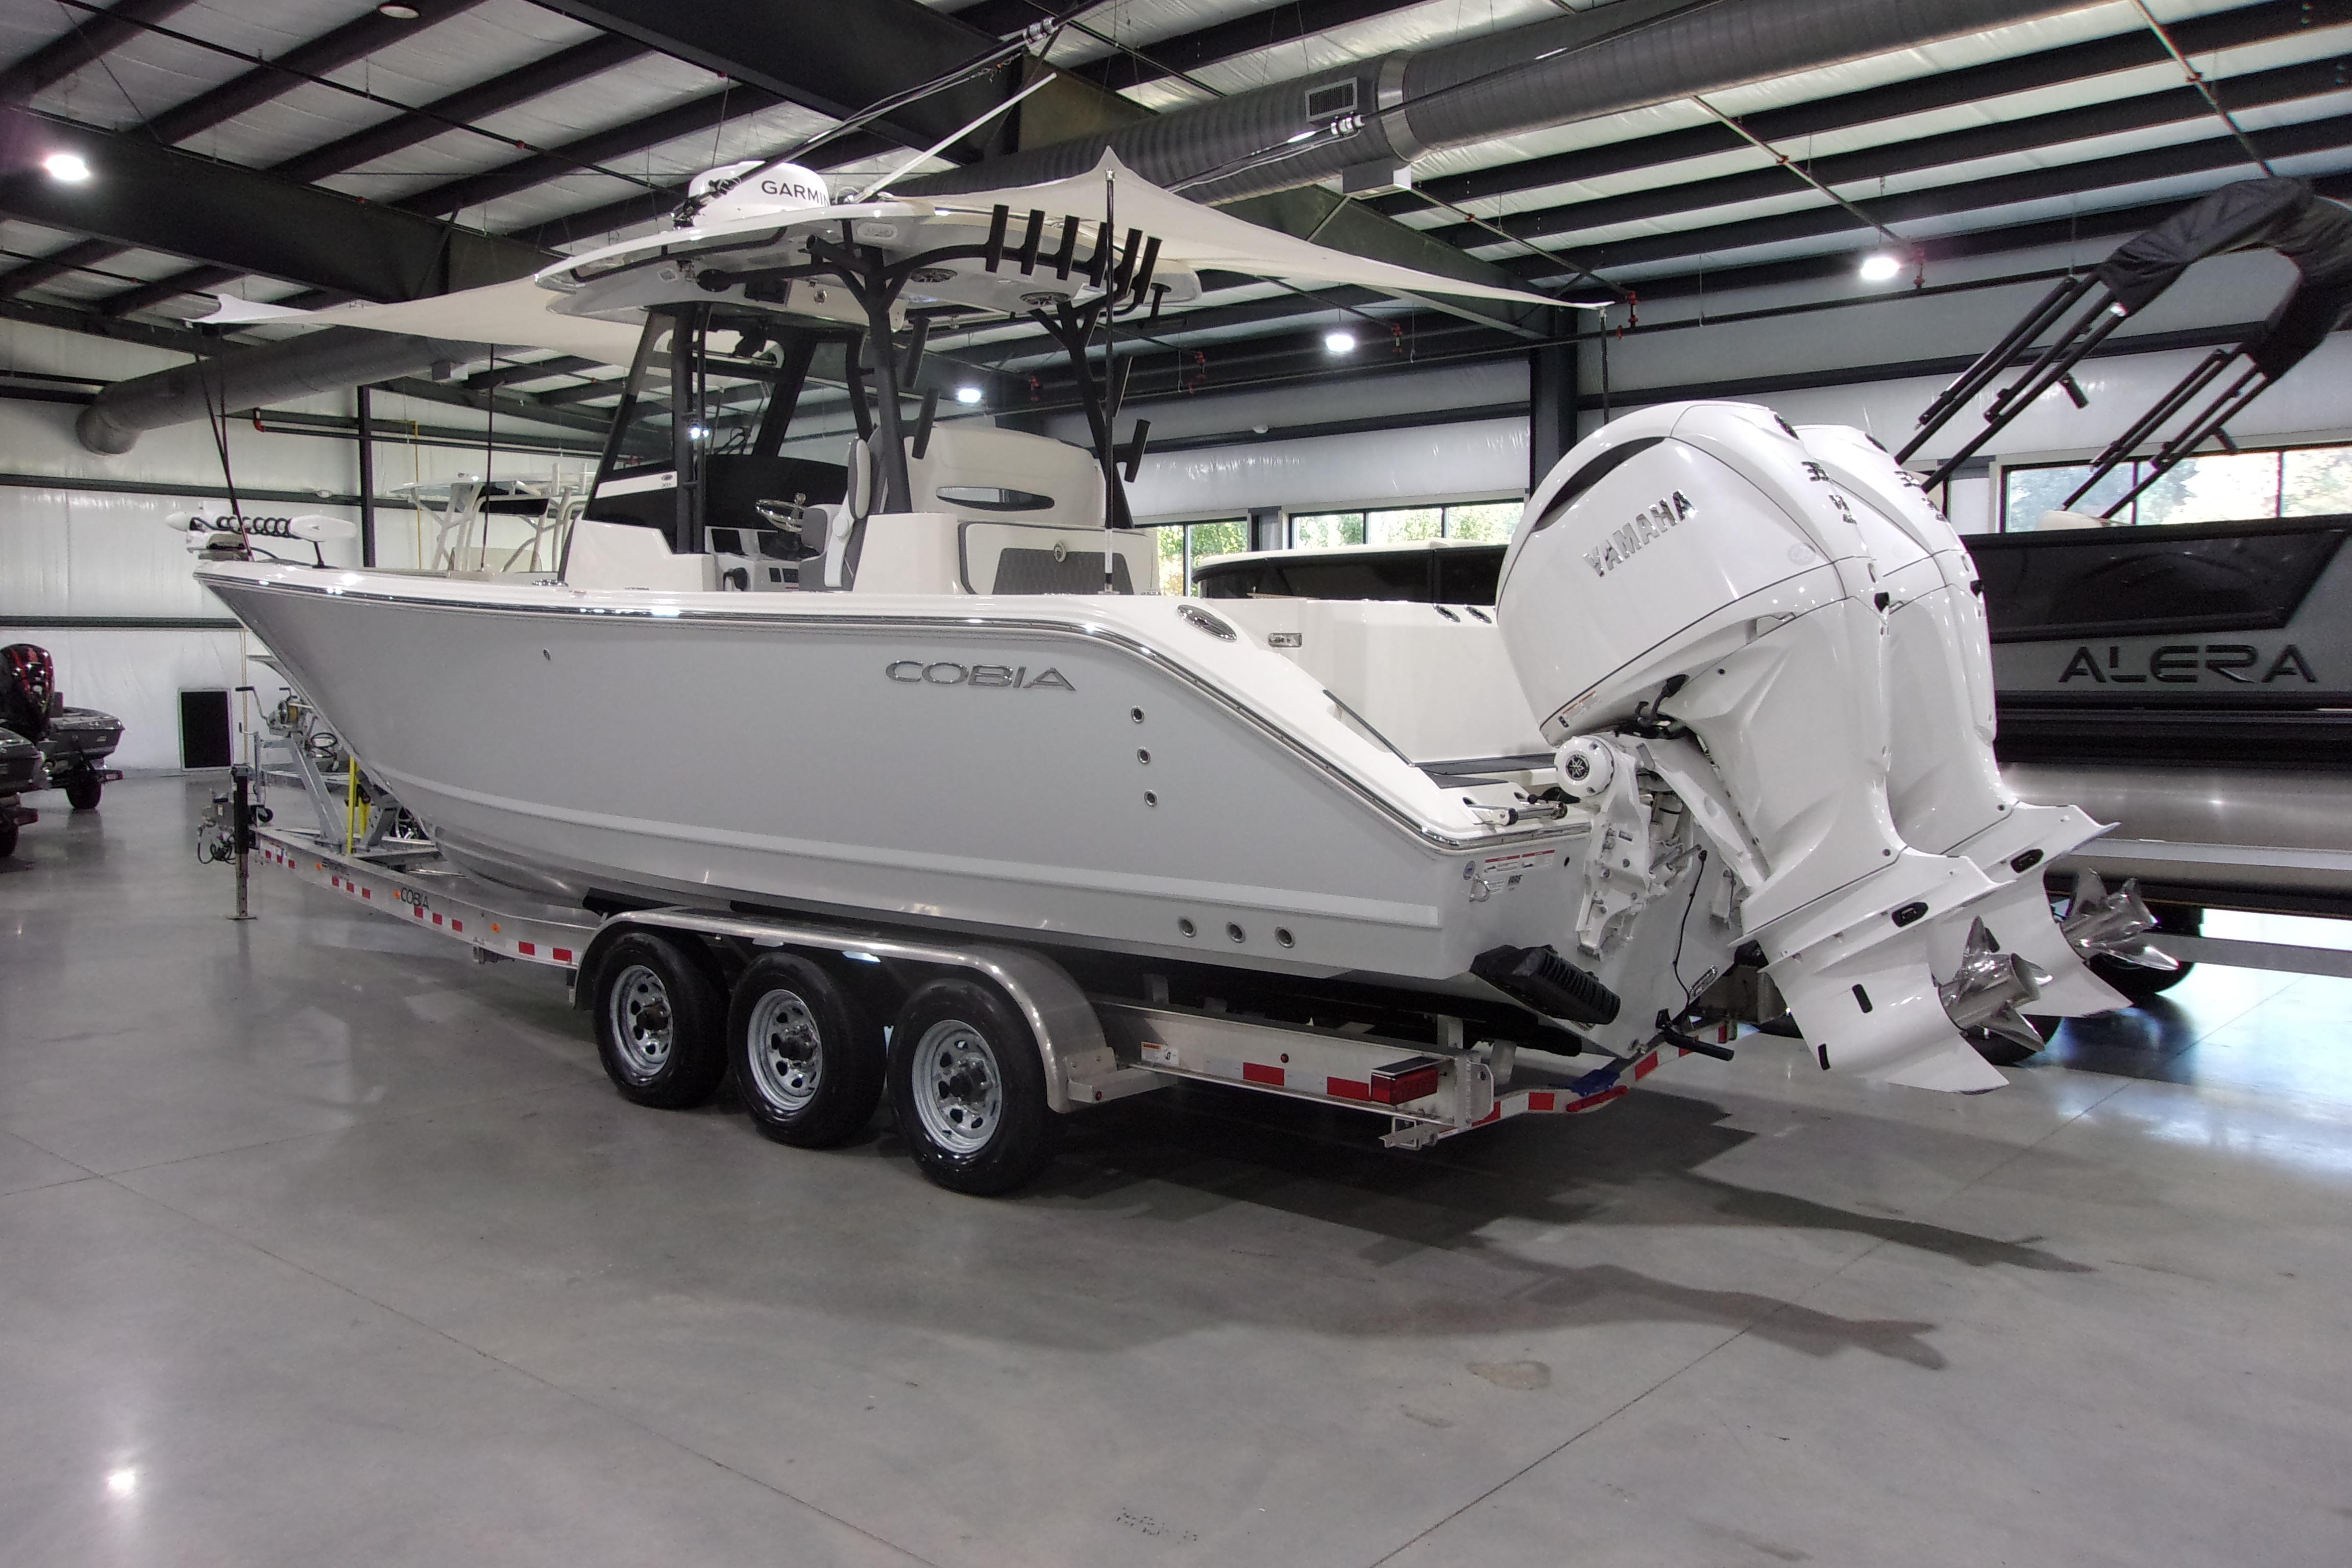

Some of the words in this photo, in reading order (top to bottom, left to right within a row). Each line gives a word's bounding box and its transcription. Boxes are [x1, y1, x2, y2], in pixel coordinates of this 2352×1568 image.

[761, 180, 829, 207] GARMIN
[1583, 488, 1698, 577] YAMAHA
[886, 660, 1076, 691] COBIA
[2058, 644, 2318, 683] ALERA
